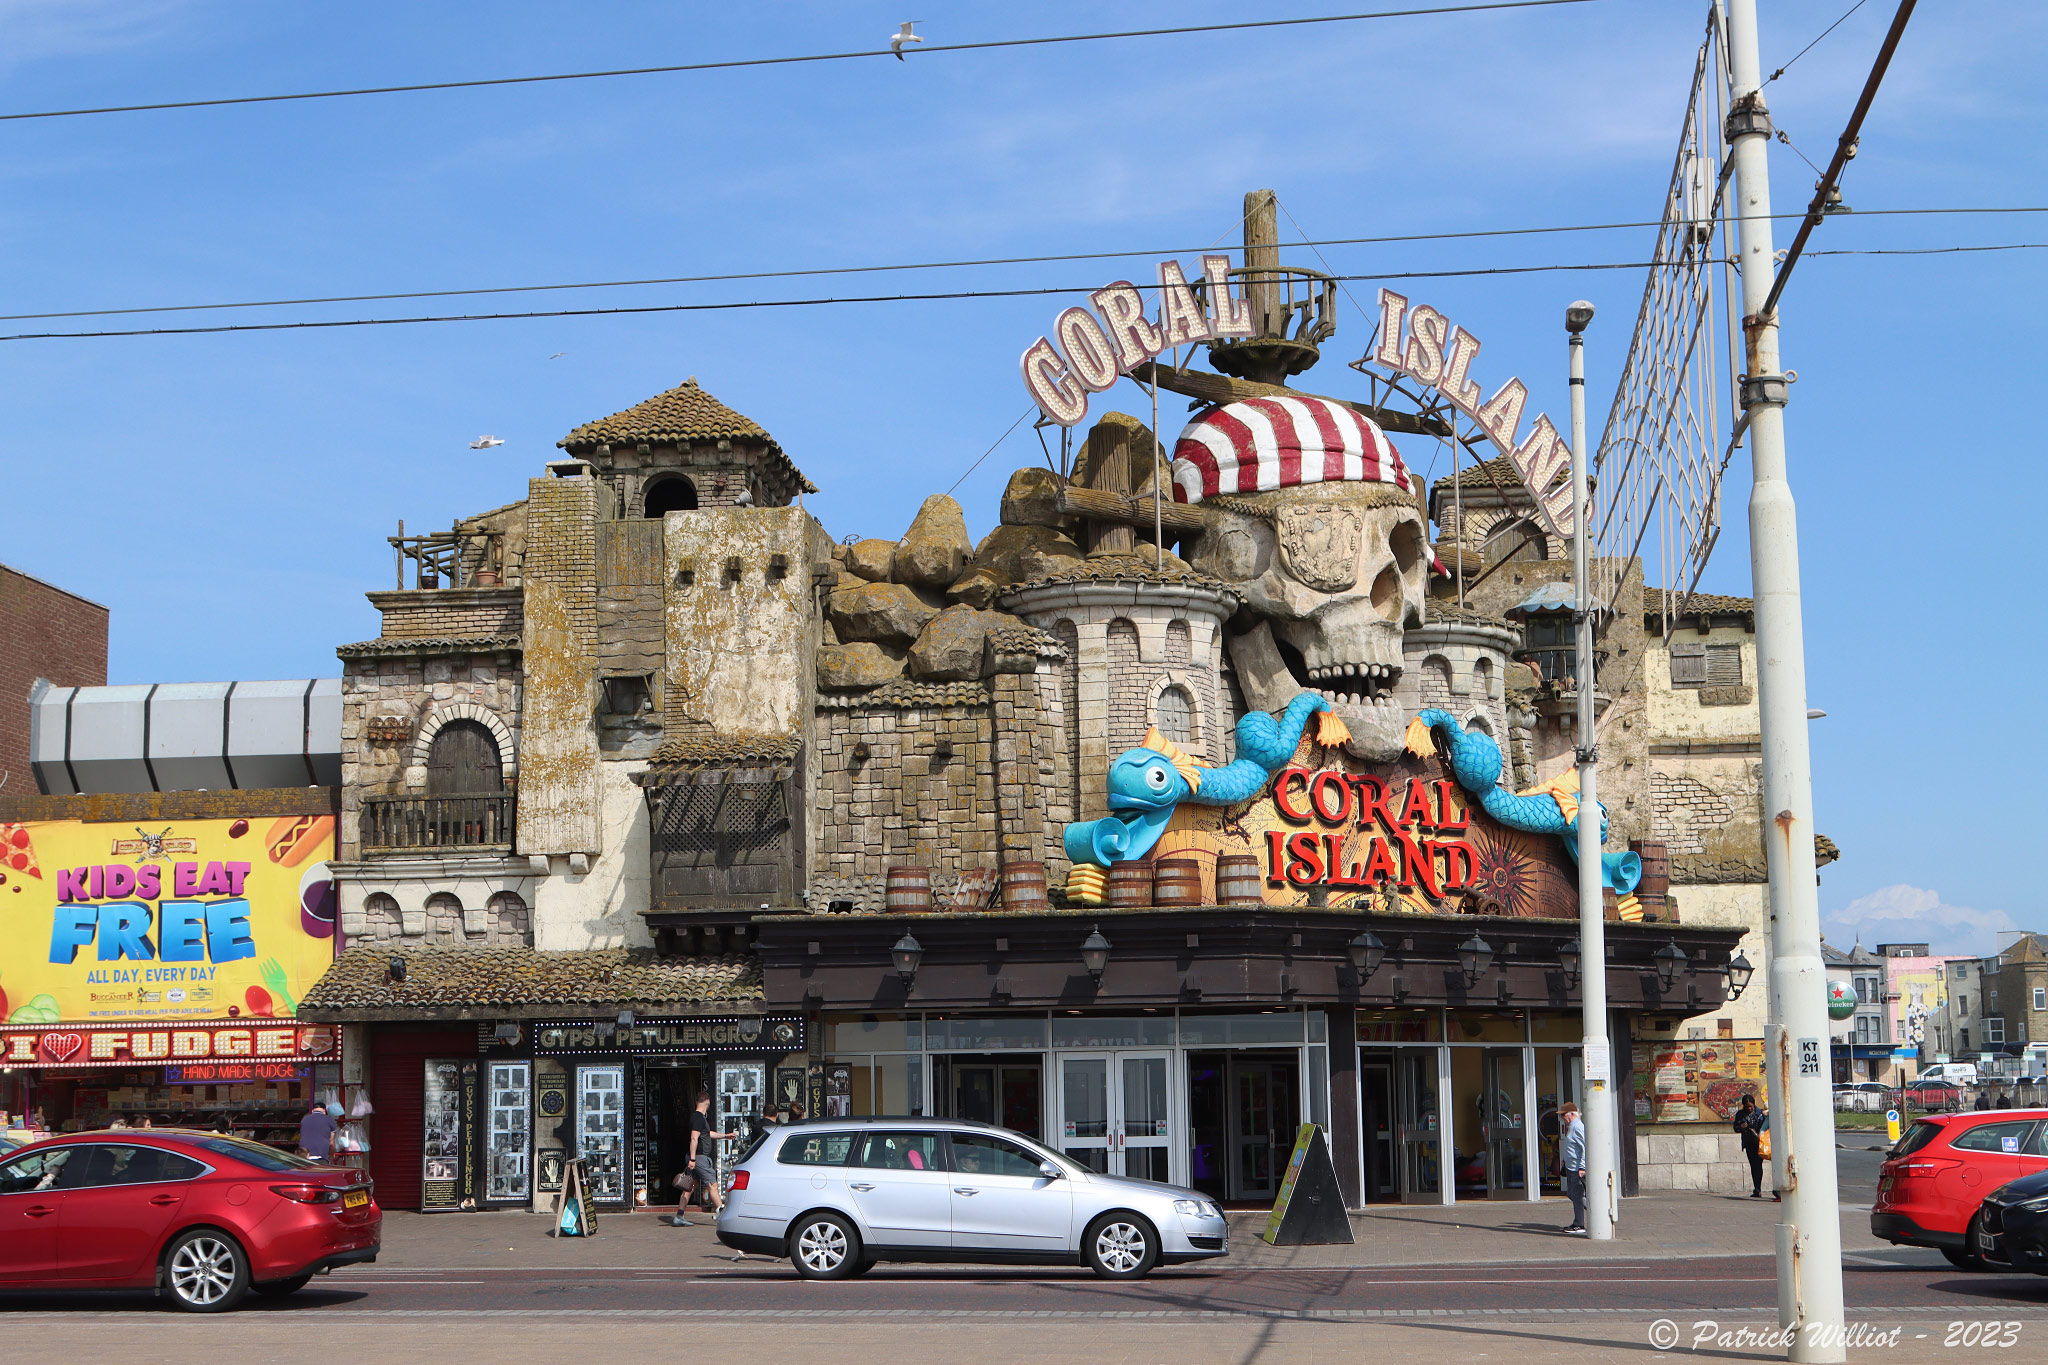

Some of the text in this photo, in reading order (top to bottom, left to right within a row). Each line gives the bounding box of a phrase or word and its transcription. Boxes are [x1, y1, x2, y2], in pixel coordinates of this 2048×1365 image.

[1019, 255, 1595, 539] CORAL ISLAND
[1271, 767, 1469, 838] CORAL
[1264, 830, 1480, 899] ISLAND
[57, 861, 251, 903] KIDS EAT
[48, 897, 256, 964] FREE
[87, 966, 216, 984] ALL DAY, EVERY DAY
[90, 992, 134, 1002] BUCCANEER
[90, 1029, 296, 1060] FUDGE
[541, 1025, 758, 1048] GYPSY PETULENGRO
[1802, 1042, 1818, 1051] KT
[183, 1064, 295, 1079] HAND MADE FUDGE
[1801, 1063, 1818, 1073] 211
[1804, 1053, 1818, 1062] 04
[466, 1086, 474, 1122] GYPSY
[465, 1124, 474, 1195] PETULENGRO
